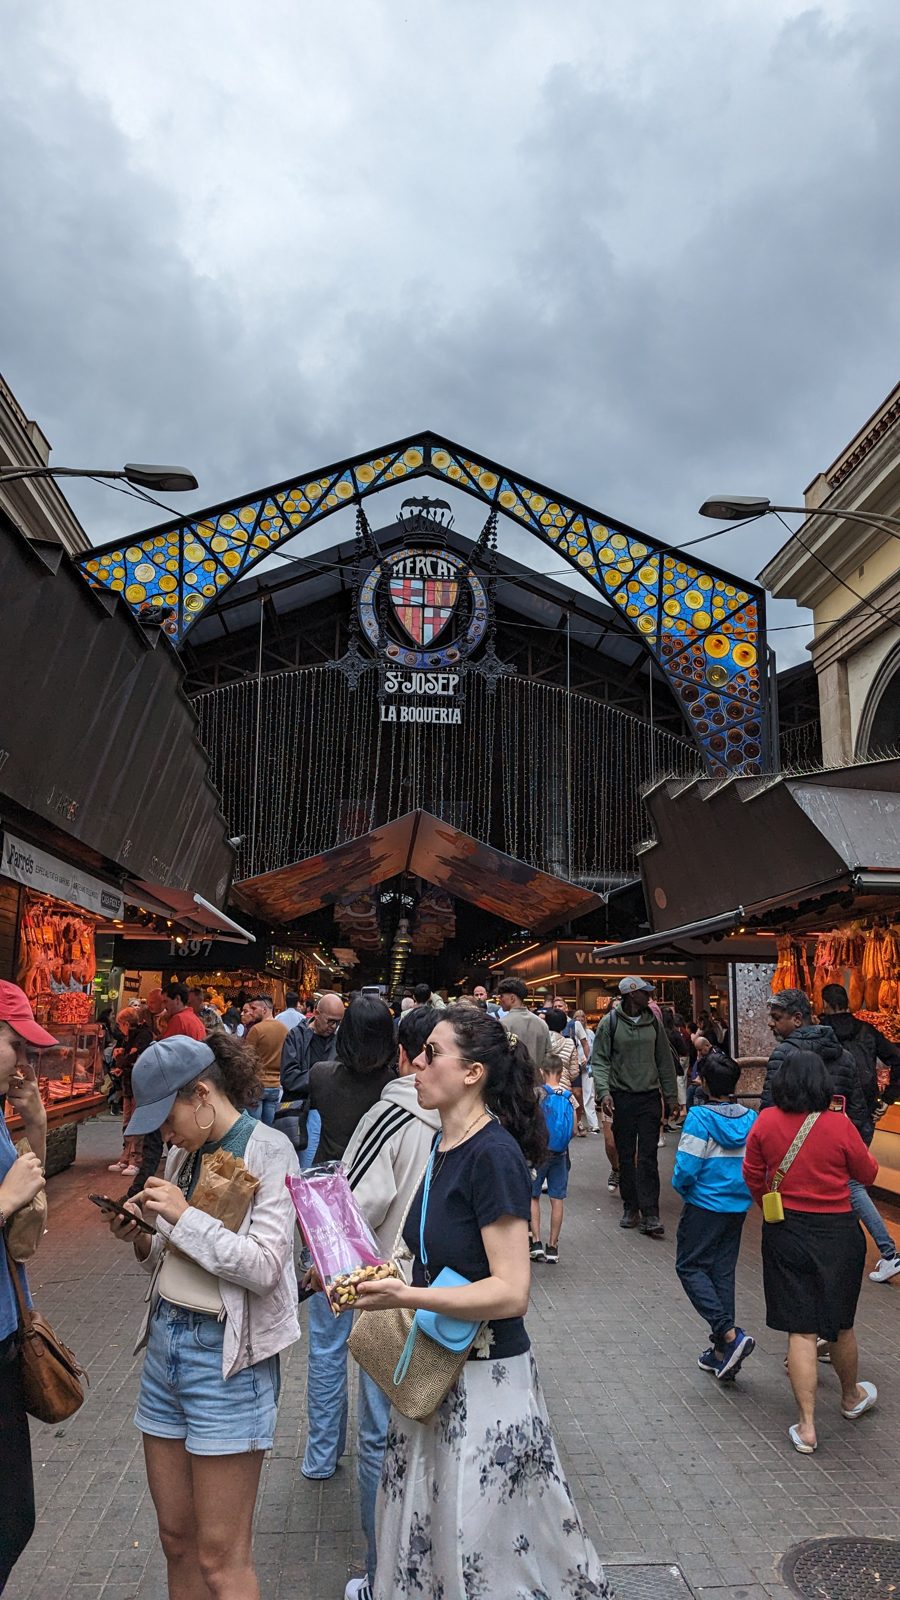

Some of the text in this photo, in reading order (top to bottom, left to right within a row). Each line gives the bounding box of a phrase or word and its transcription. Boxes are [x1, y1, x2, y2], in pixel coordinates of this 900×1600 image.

[392, 556, 457, 579] MERCAT
[401, 672, 460, 695] JOSEP
[381, 705, 462, 724] LA BOQUERIA
[168, 940, 213, 957] 1897
